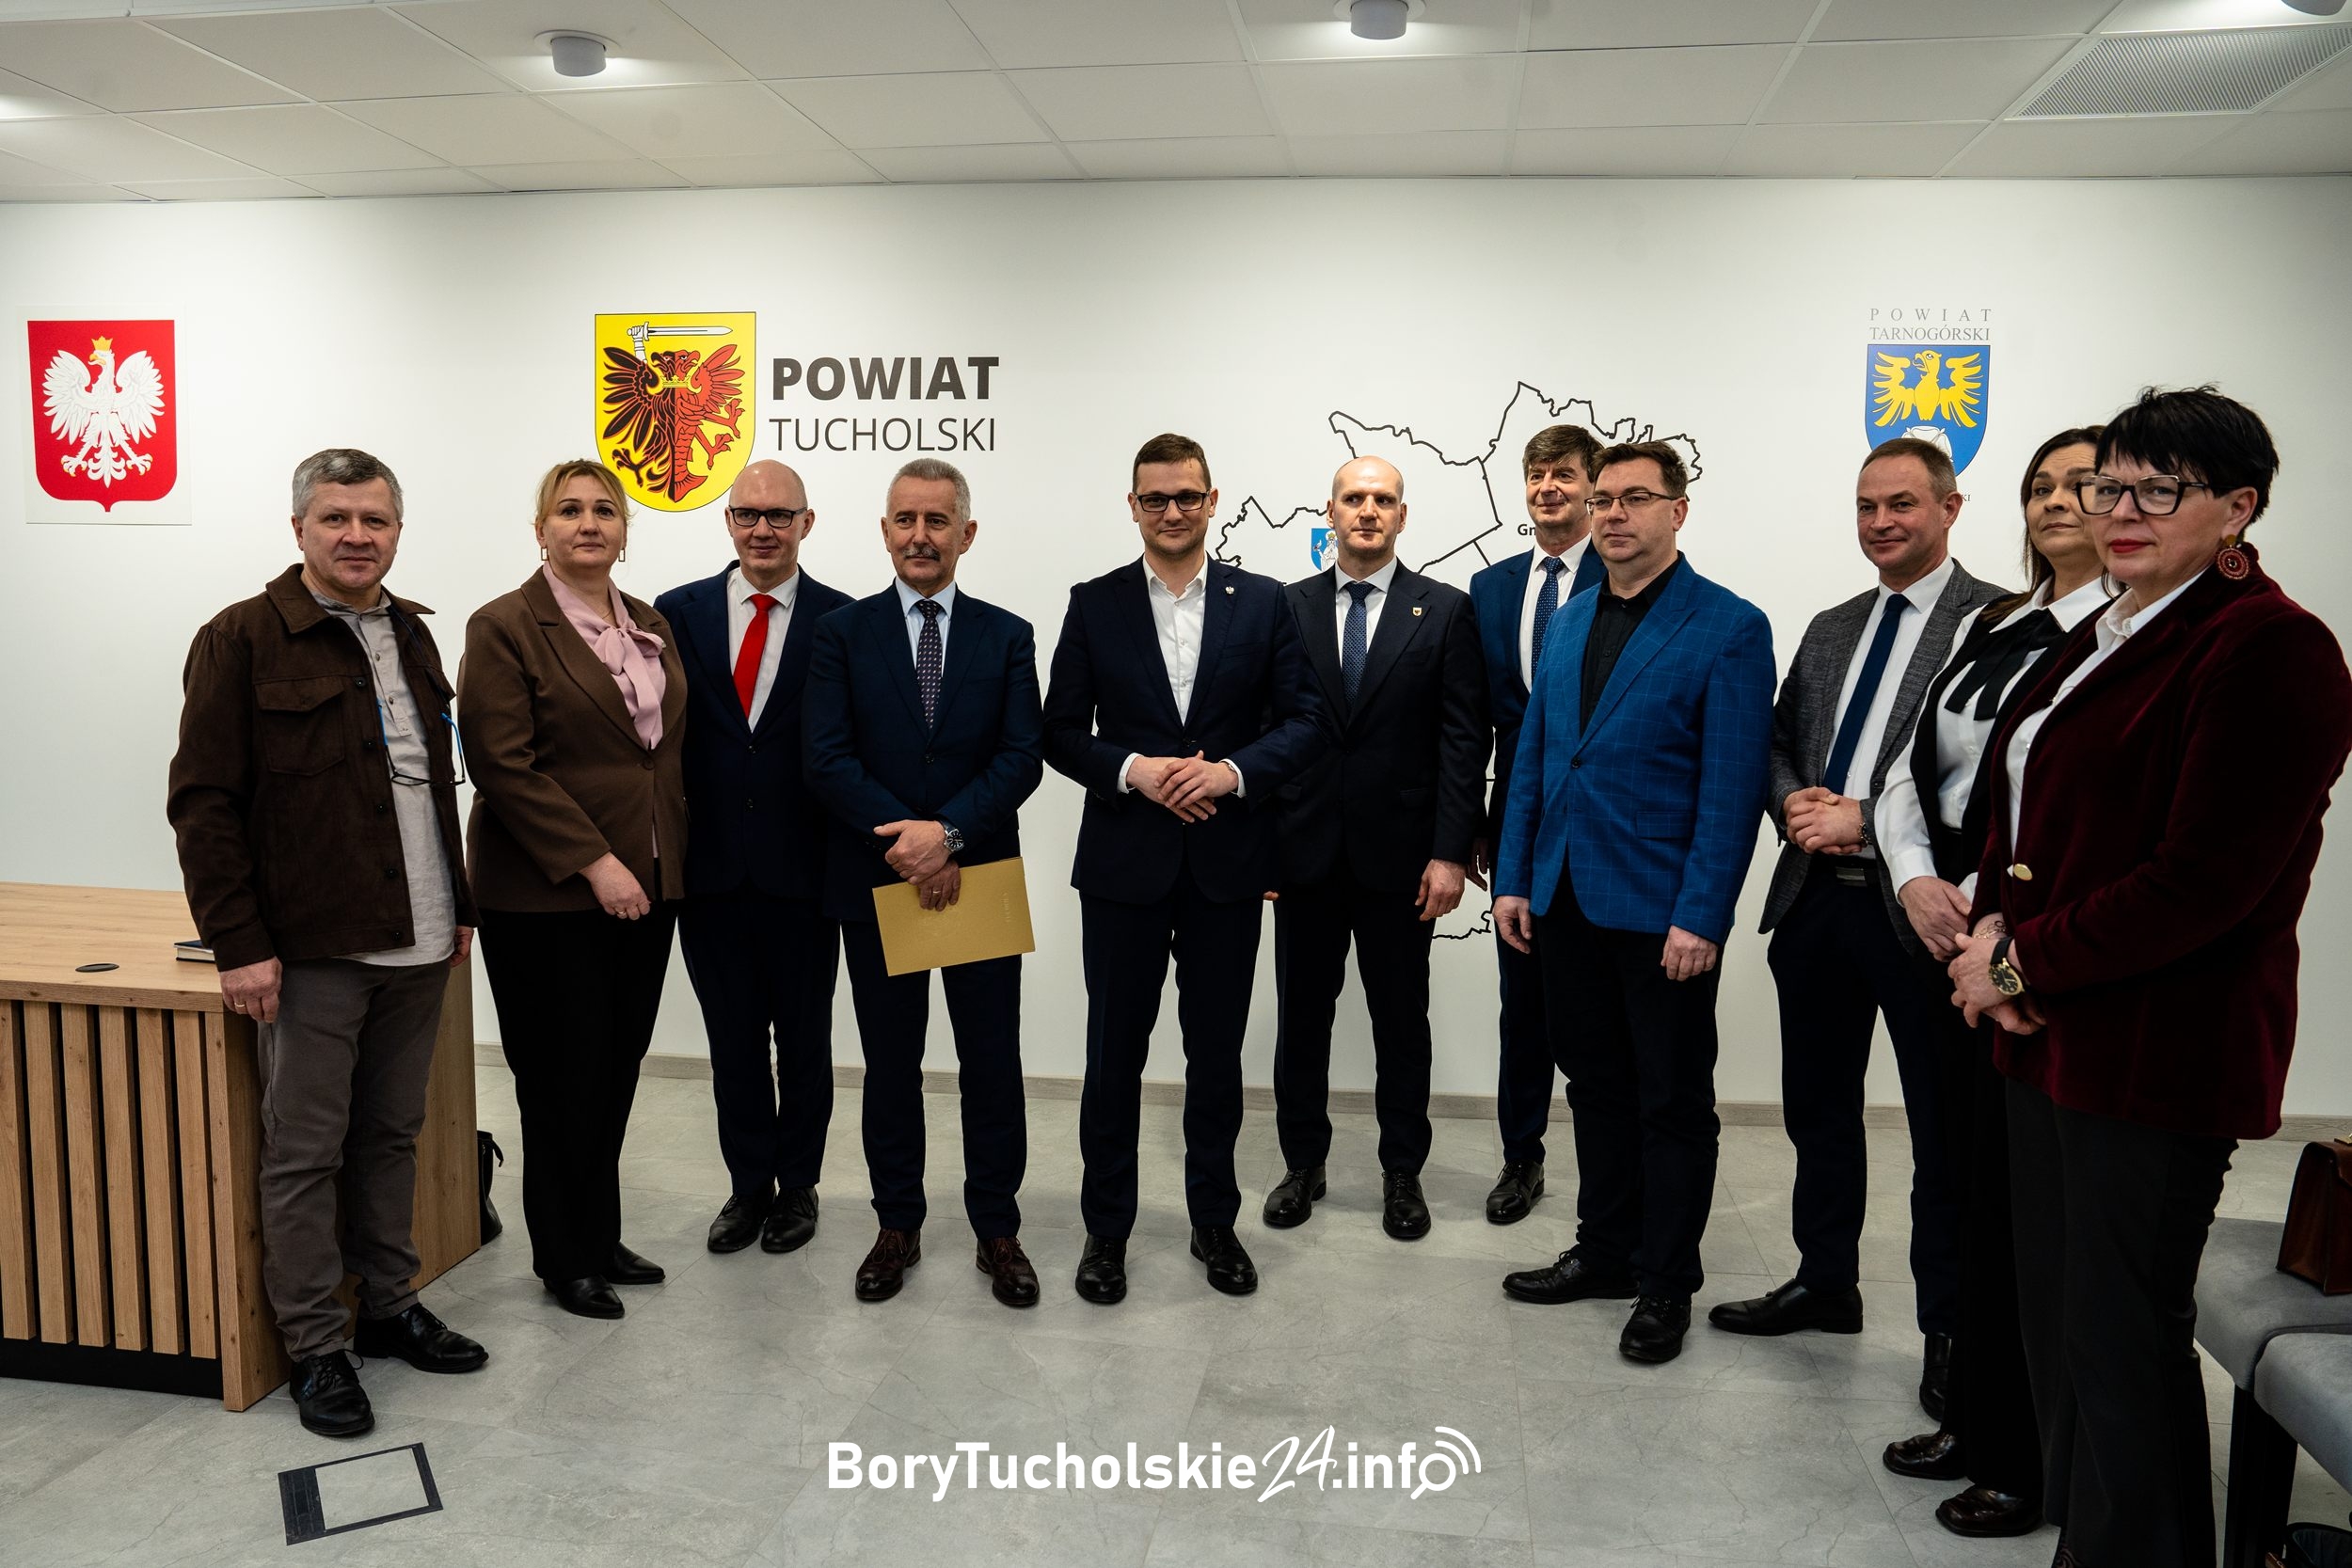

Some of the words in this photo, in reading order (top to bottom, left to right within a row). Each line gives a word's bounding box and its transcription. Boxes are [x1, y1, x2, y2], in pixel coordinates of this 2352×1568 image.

[1869, 308, 1992, 322] POWIAT
[1869, 325, 1990, 341] TARNOGÓRSKI
[772, 356, 1000, 401] POWIAT
[769, 417, 995, 451] TUCHOLSKI
